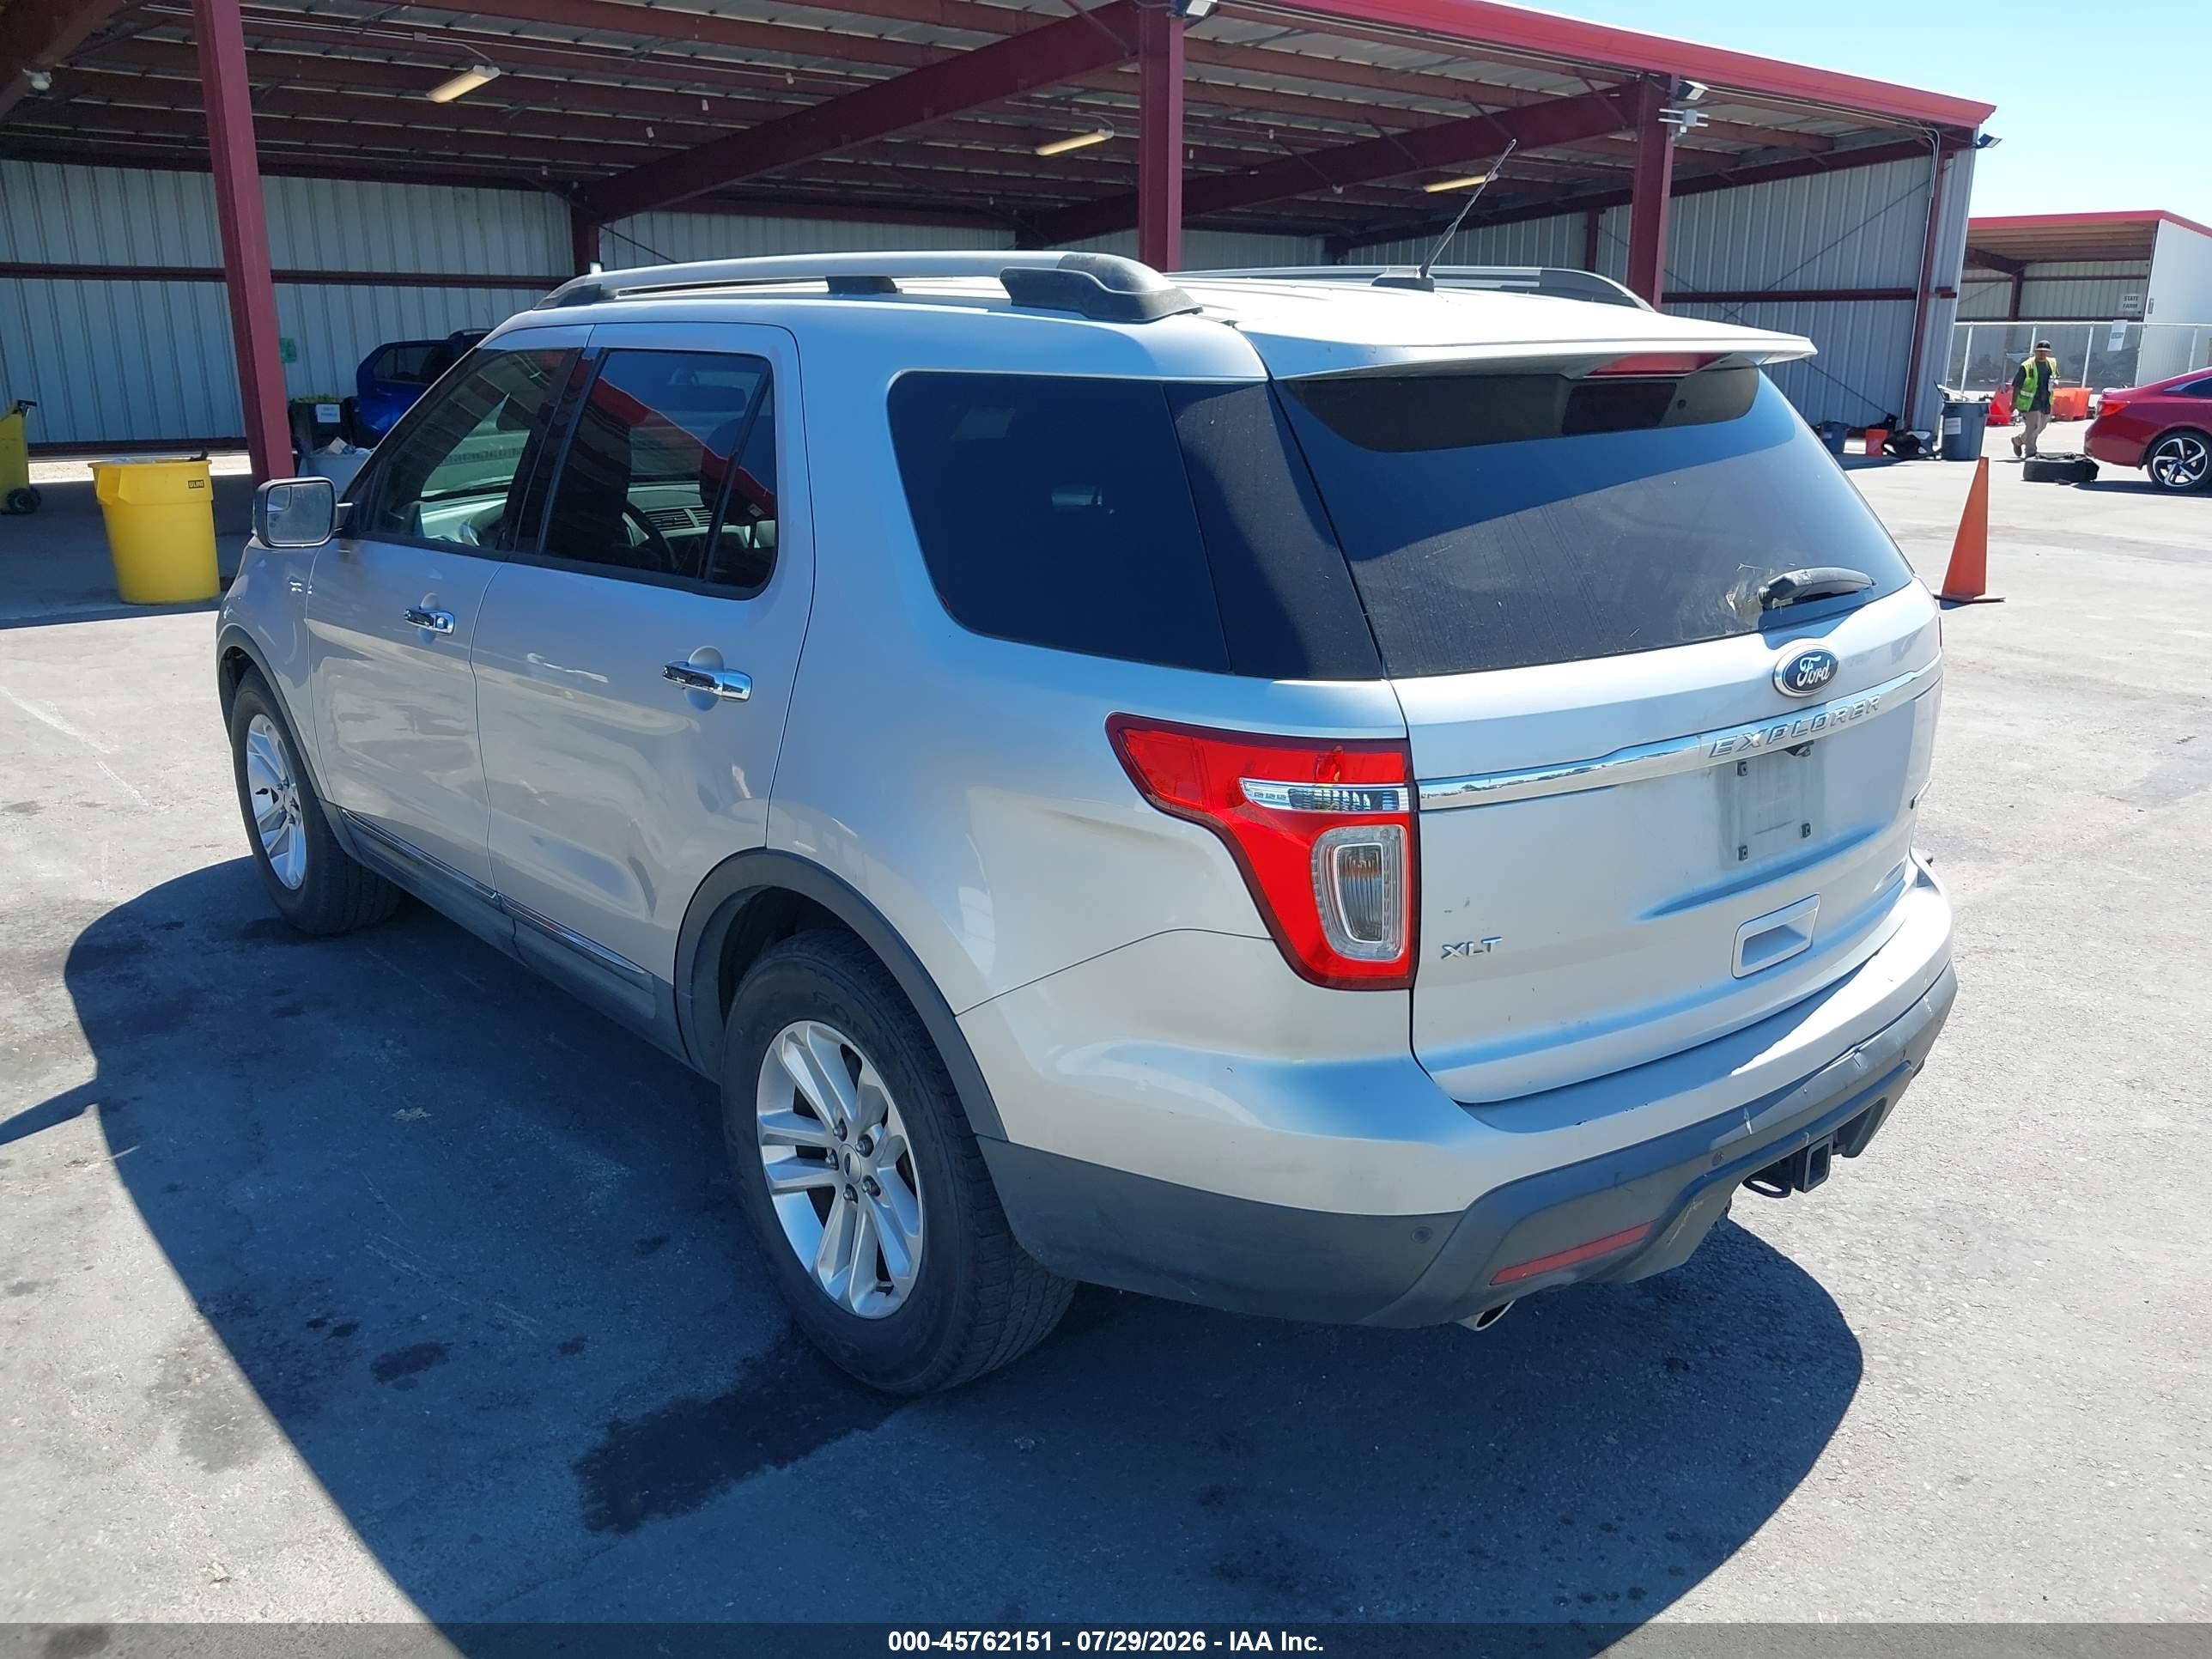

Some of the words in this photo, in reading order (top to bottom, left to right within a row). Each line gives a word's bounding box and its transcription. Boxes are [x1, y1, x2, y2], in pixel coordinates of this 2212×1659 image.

[1796, 655, 1831, 687] Ford
[1709, 693, 1882, 758] EXPLORER
[1441, 936, 1503, 959] XLT
